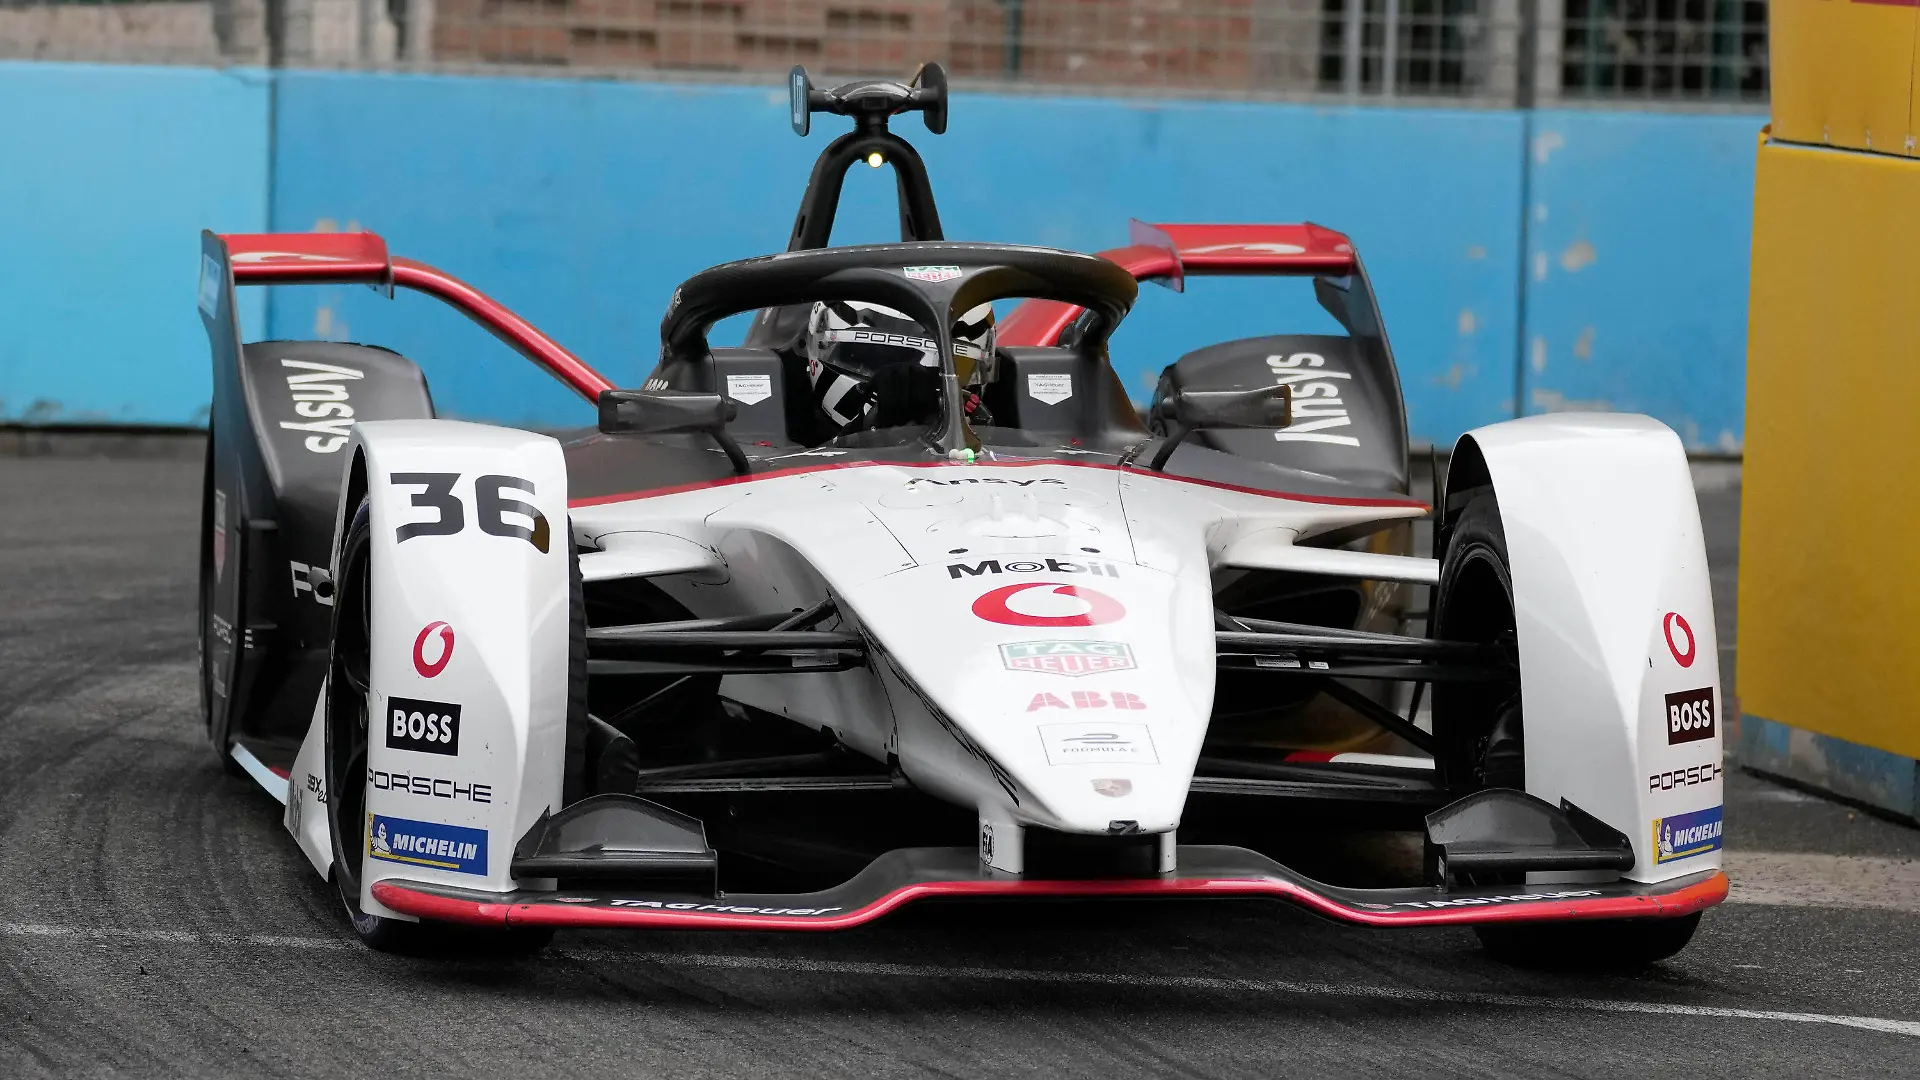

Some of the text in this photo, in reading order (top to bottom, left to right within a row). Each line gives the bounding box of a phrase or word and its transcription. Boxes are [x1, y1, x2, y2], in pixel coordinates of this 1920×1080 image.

[854, 331, 968, 356] PORSCE
[279, 358, 365, 453] Ansys
[1266, 353, 1360, 447] Ansys
[390, 472, 550, 554] 36
[946, 558, 1120, 580] Mobil
[1013, 642, 1118, 656] TAG
[1012, 655, 1127, 674] HEUER
[1026, 691, 1148, 712] ABB
[392, 709, 452, 744] BOSS
[1670, 699, 1711, 733] BOSS
[368, 767, 492, 803] PORSCHE
[1649, 763, 1724, 793] PORSCH
[392, 833, 478, 860] MICHELIN
[1674, 820, 1723, 847] MICHELIN
